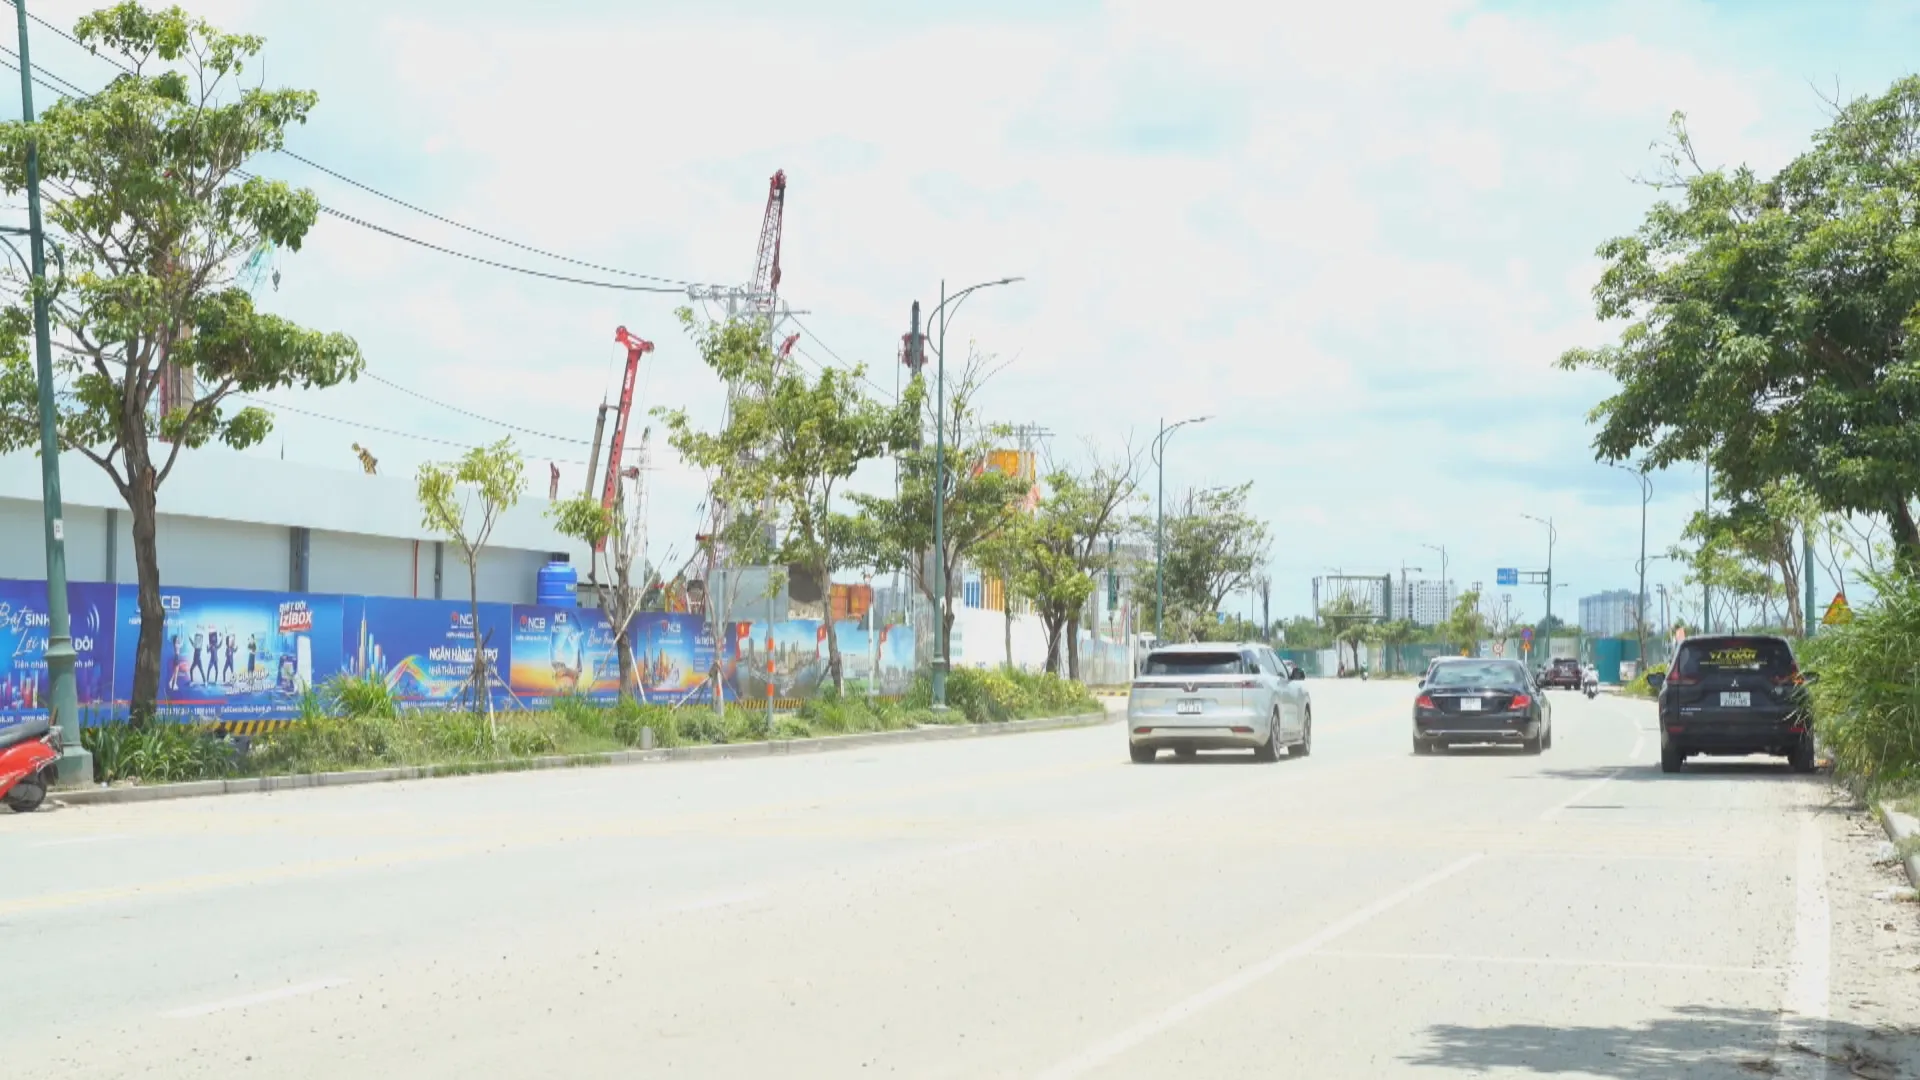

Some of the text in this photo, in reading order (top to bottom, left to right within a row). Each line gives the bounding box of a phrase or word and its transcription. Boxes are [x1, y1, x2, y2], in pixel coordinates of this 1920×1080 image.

[528, 616, 546, 629] NCB
[75, 635, 93, 651] ĐÔI
[429, 644, 450, 661] NGÂN
[451, 644, 472, 661] HÀNG
